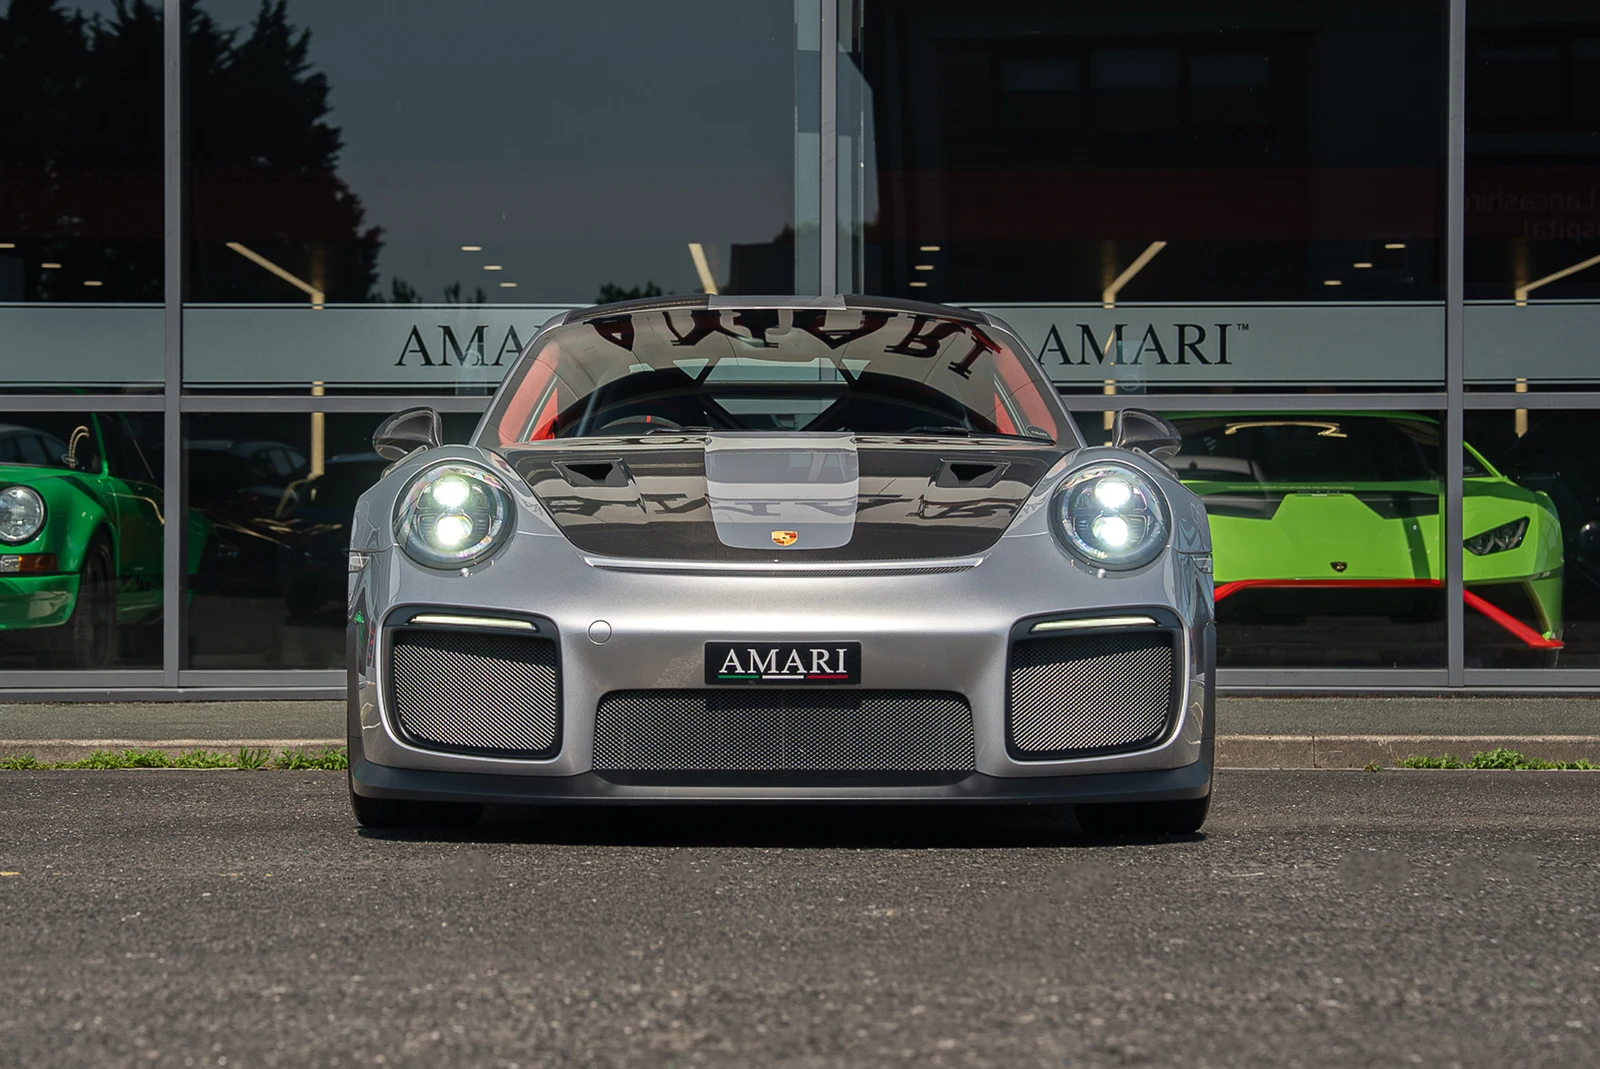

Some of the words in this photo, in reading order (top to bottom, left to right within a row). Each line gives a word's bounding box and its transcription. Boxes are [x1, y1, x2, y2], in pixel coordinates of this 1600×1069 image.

[394, 324, 542, 366] AMA
[1036, 323, 1233, 365] AMARI
[718, 648, 848, 674] AMARI
